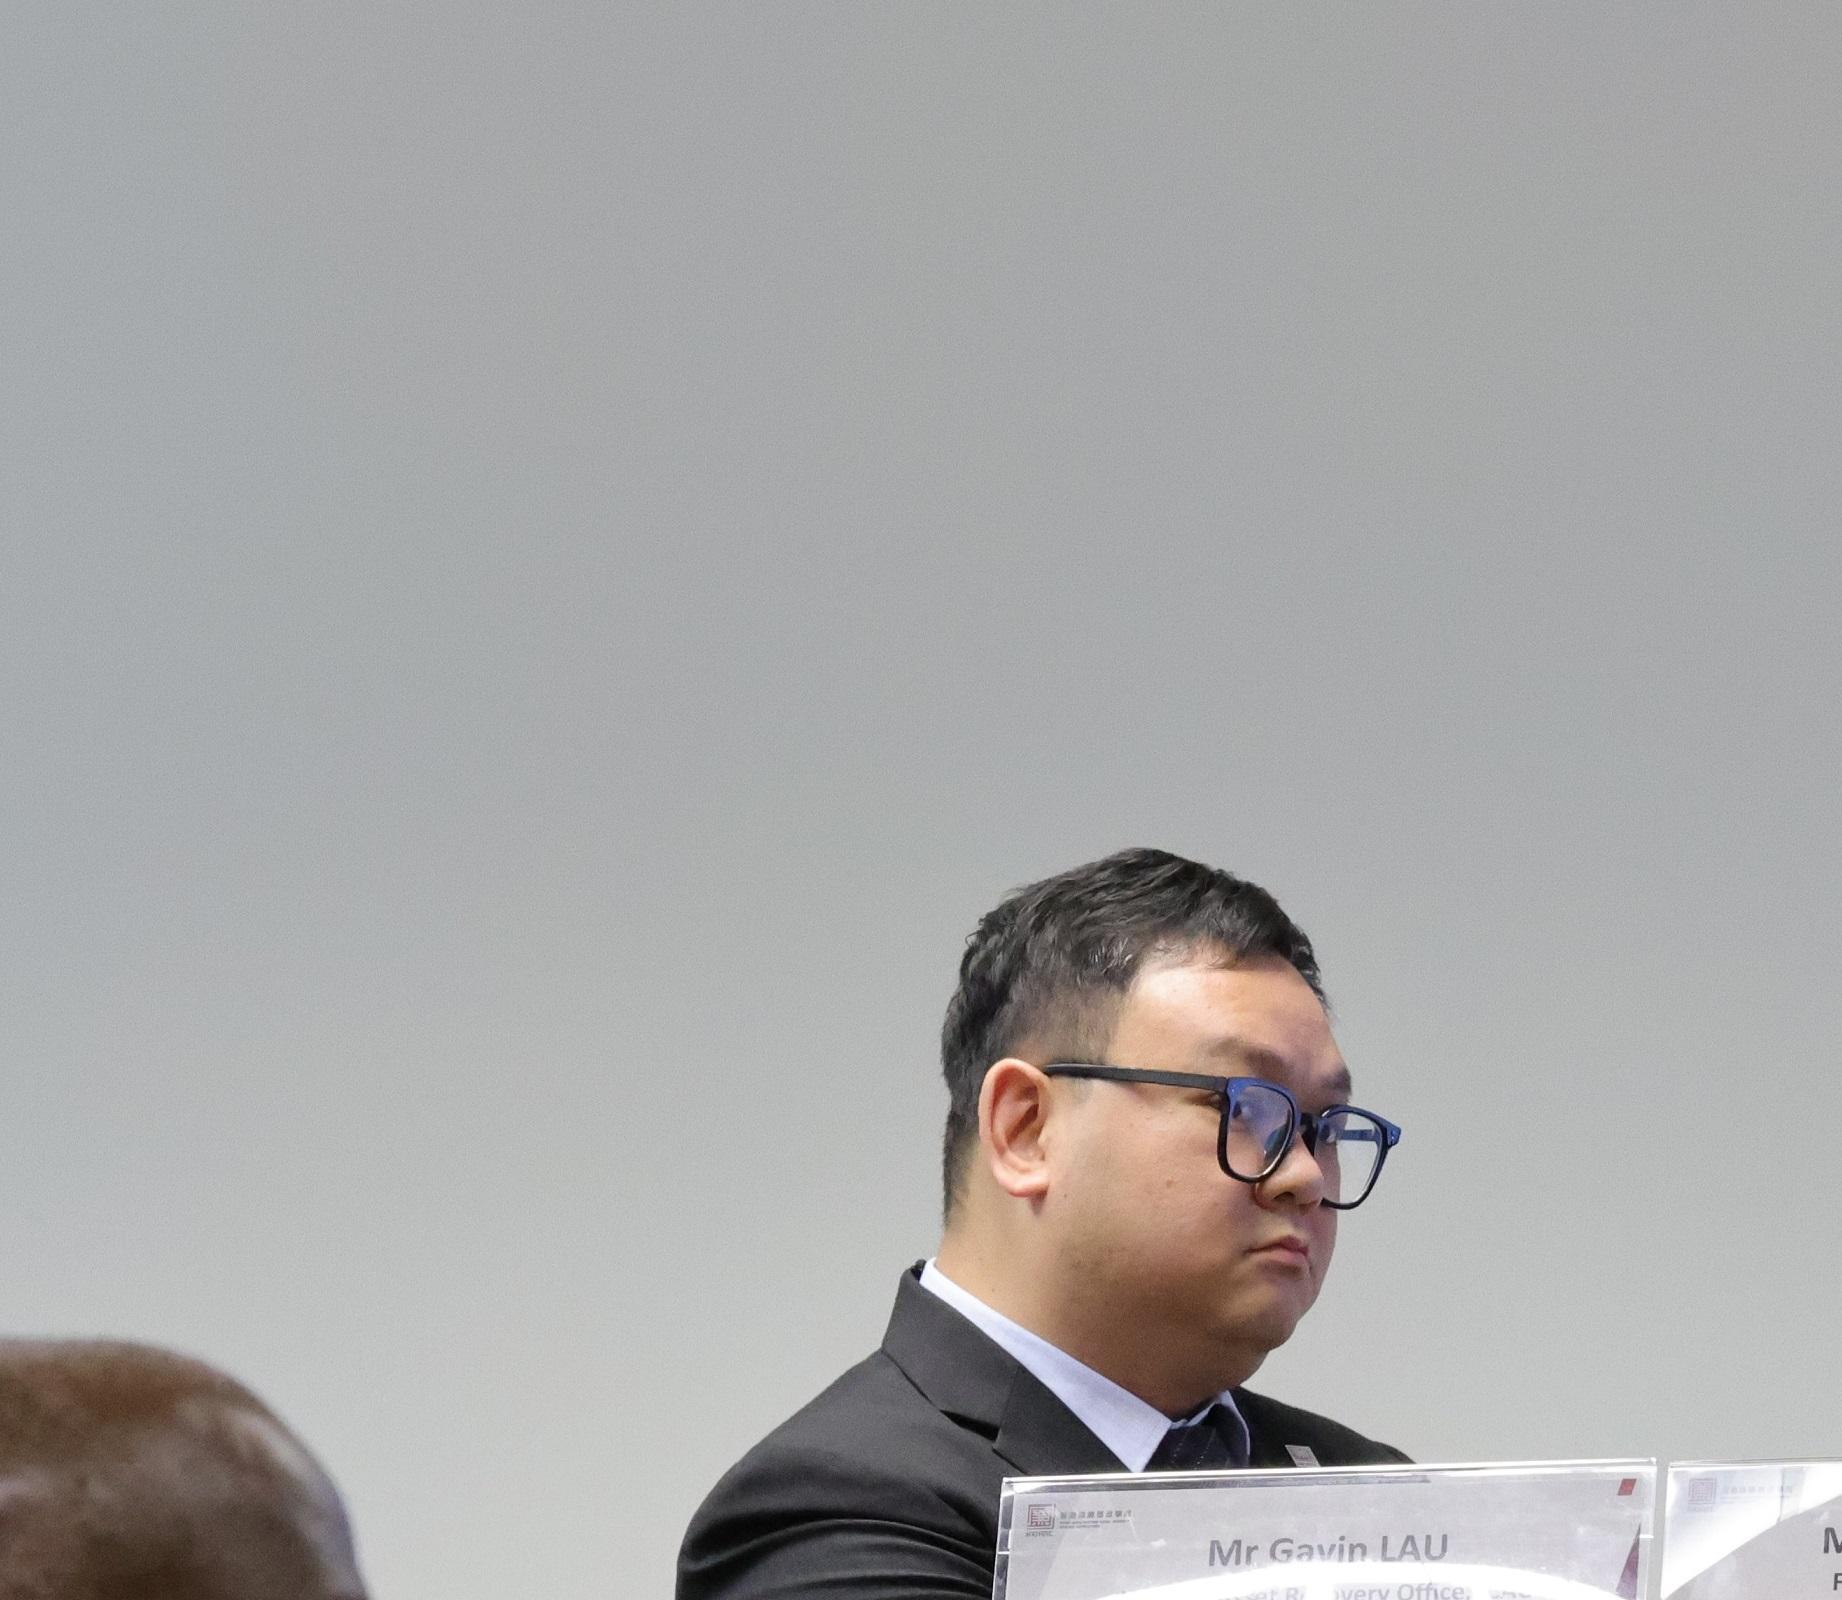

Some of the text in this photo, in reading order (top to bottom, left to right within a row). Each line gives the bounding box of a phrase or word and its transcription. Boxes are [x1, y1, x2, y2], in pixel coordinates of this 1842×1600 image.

[1208, 1533, 1449, 1567] Mr Gavin LAU
